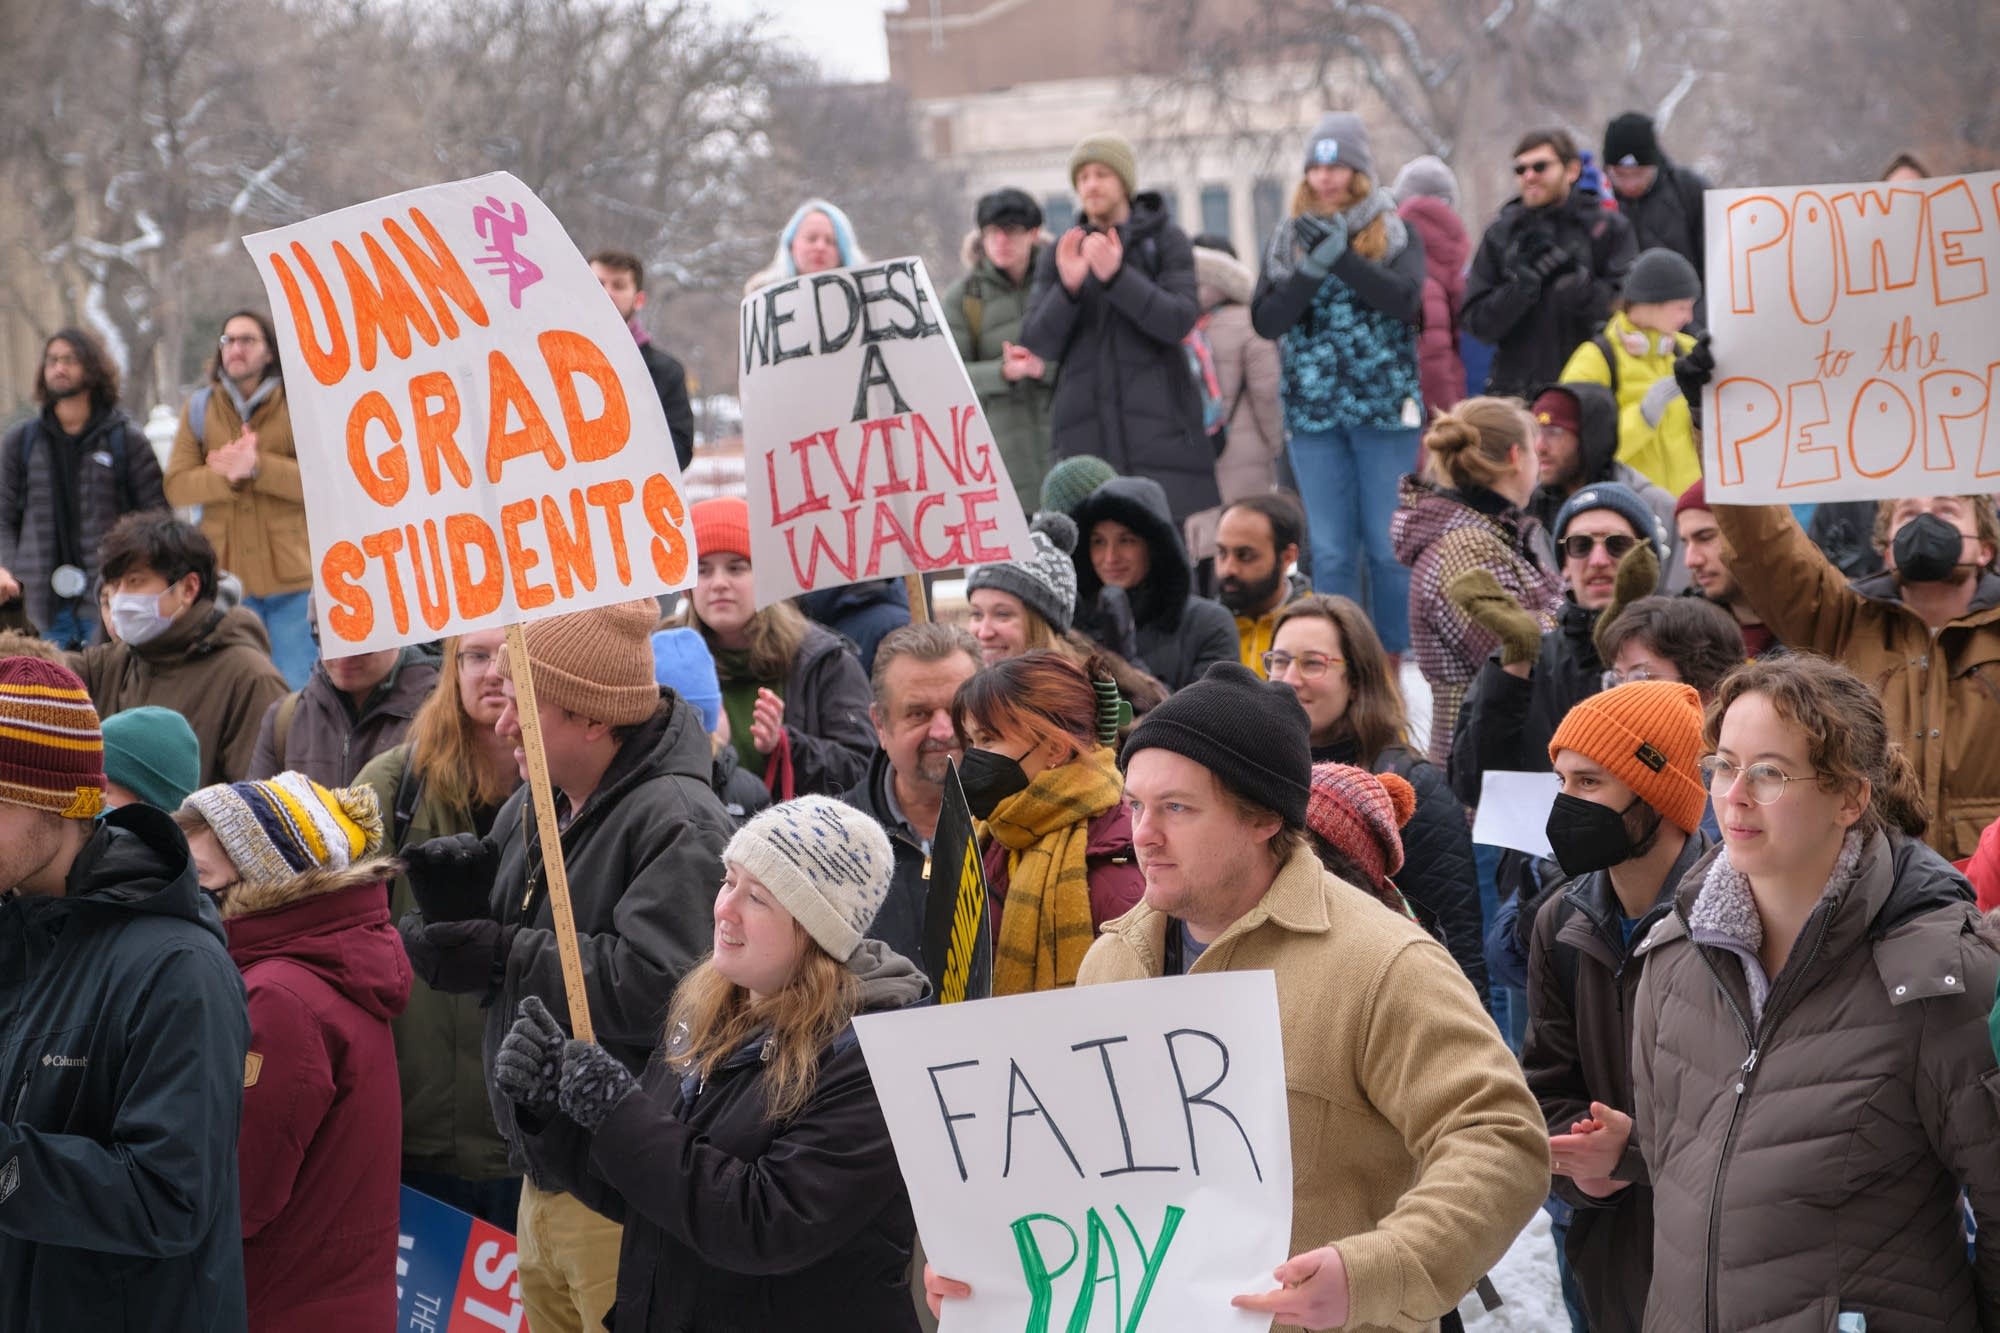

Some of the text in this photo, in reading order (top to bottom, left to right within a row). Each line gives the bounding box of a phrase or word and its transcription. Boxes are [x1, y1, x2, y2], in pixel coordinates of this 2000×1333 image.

[271, 208, 489, 385] UMN
[1728, 178, 2000, 324] POWE
[742, 280, 812, 375] WE
[851, 344, 912, 423] A
[1814, 315, 1947, 379] to the
[347, 330, 631, 507] GRAD
[765, 405, 998, 527] LIVING
[321, 473, 689, 643] STUDENTS
[783, 489, 1012, 591] WAGE
[940, 834, 985, 1005] RGANIZE!
[928, 1028, 1263, 1183] FAIR
[409, 1292, 442, 1333] THE
[1009, 1204, 1186, 1333] PAY
